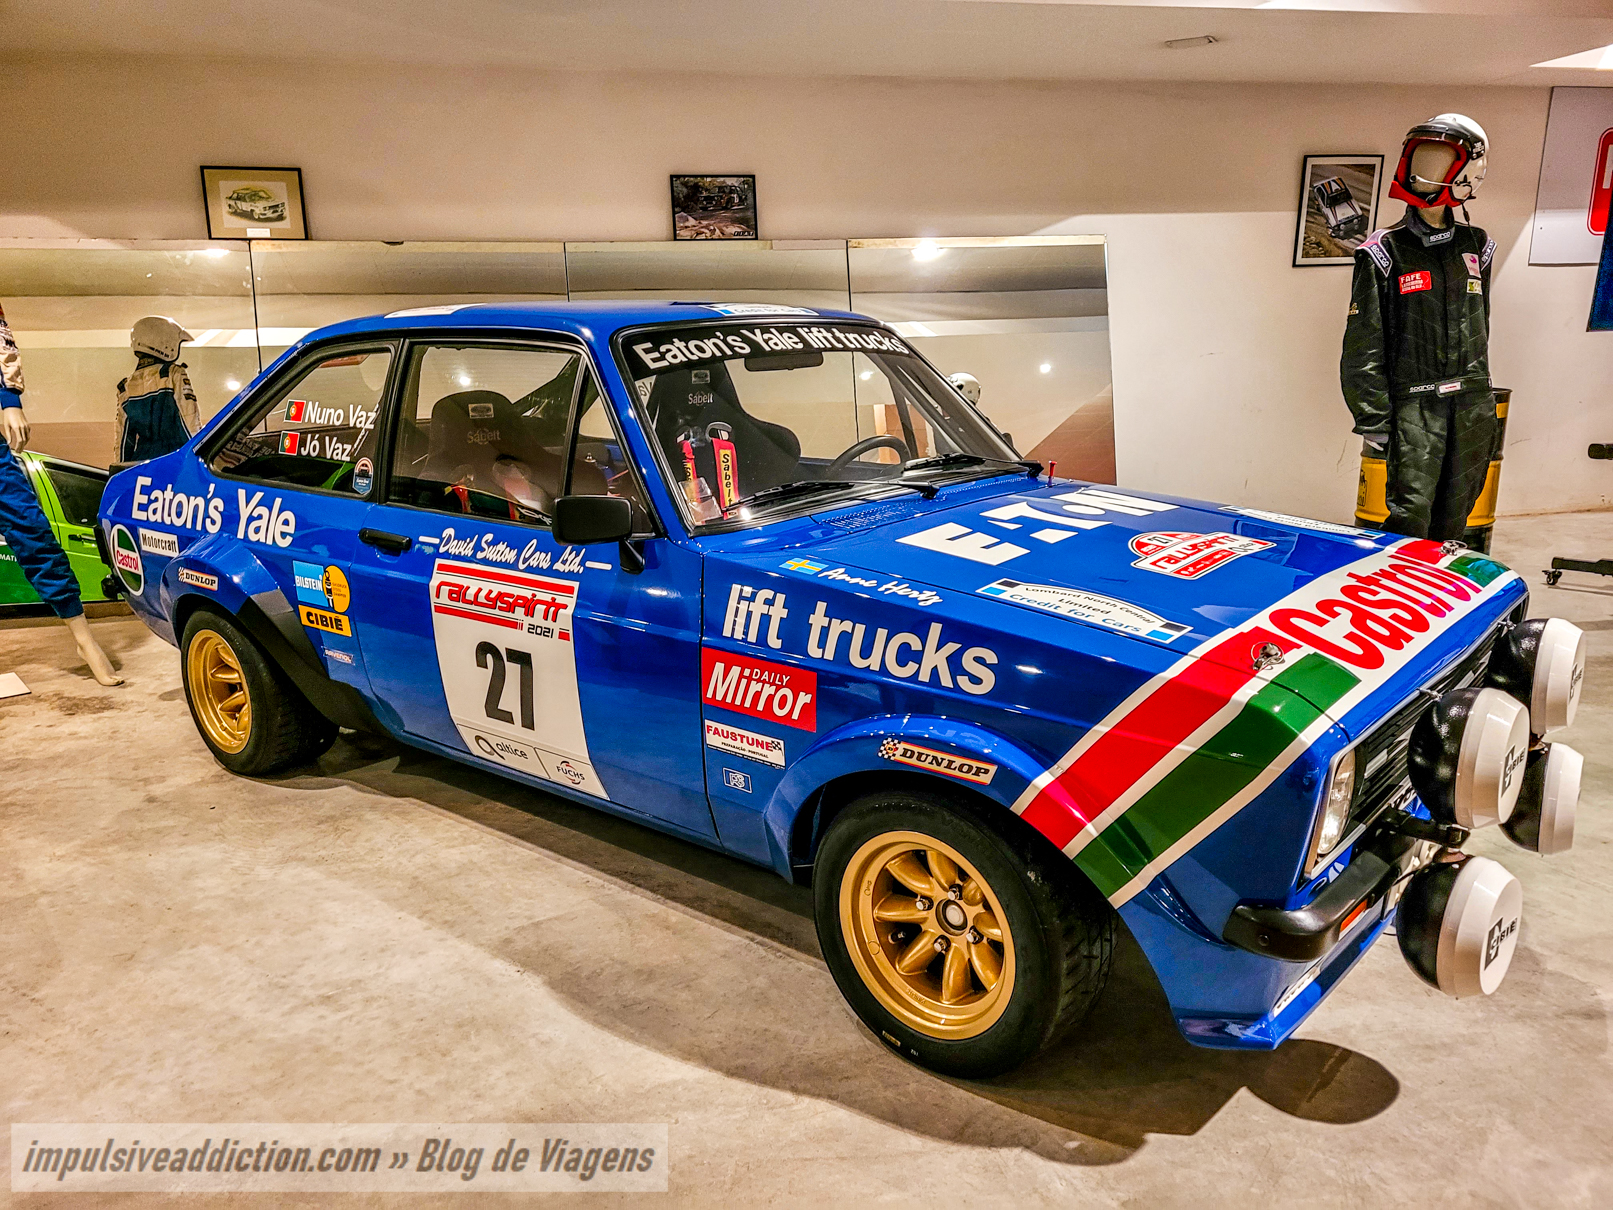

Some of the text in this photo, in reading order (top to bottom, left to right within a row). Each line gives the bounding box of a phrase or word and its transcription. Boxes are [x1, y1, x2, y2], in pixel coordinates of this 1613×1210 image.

[1400, 273, 1422, 284] FAFE
[633, 327, 909, 370] Eaton's Yale lift trucks
[688, 392, 713, 405] Sabelt
[305, 401, 377, 430] Nuno Vaz
[300, 433, 320, 457] Jó
[325, 436, 352, 462] Vaz
[132, 475, 296, 548] Eaton's Yale
[141, 533, 178, 553] Motorcraft
[438, 527, 586, 574] David Sutton Cars Ltd.
[116, 549, 140, 572] Castrol
[185, 573, 217, 587] DUNLOP
[295, 575, 323, 592] BILSTEIN
[877, 580, 944, 607] Hertz
[1009, 593, 1142, 633] Credit for Cars
[1025, 587, 1156, 624] Lombard North Central
[1058, 598, 1112, 615] Limited
[1268, 553, 1482, 670] Castrol
[527, 623, 554, 639] 2021
[722, 583, 999, 696] lift trucks
[475, 640, 535, 731] 27
[752, 668, 790, 686] DAILY
[706, 661, 812, 721] Mirror
[496, 741, 529, 760] altice
[706, 724, 774, 752] FAUSTUNE
[556, 765, 585, 781] FUCHS
[900, 747, 990, 777] DUNLOP
[729, 772, 745, 788] RS
